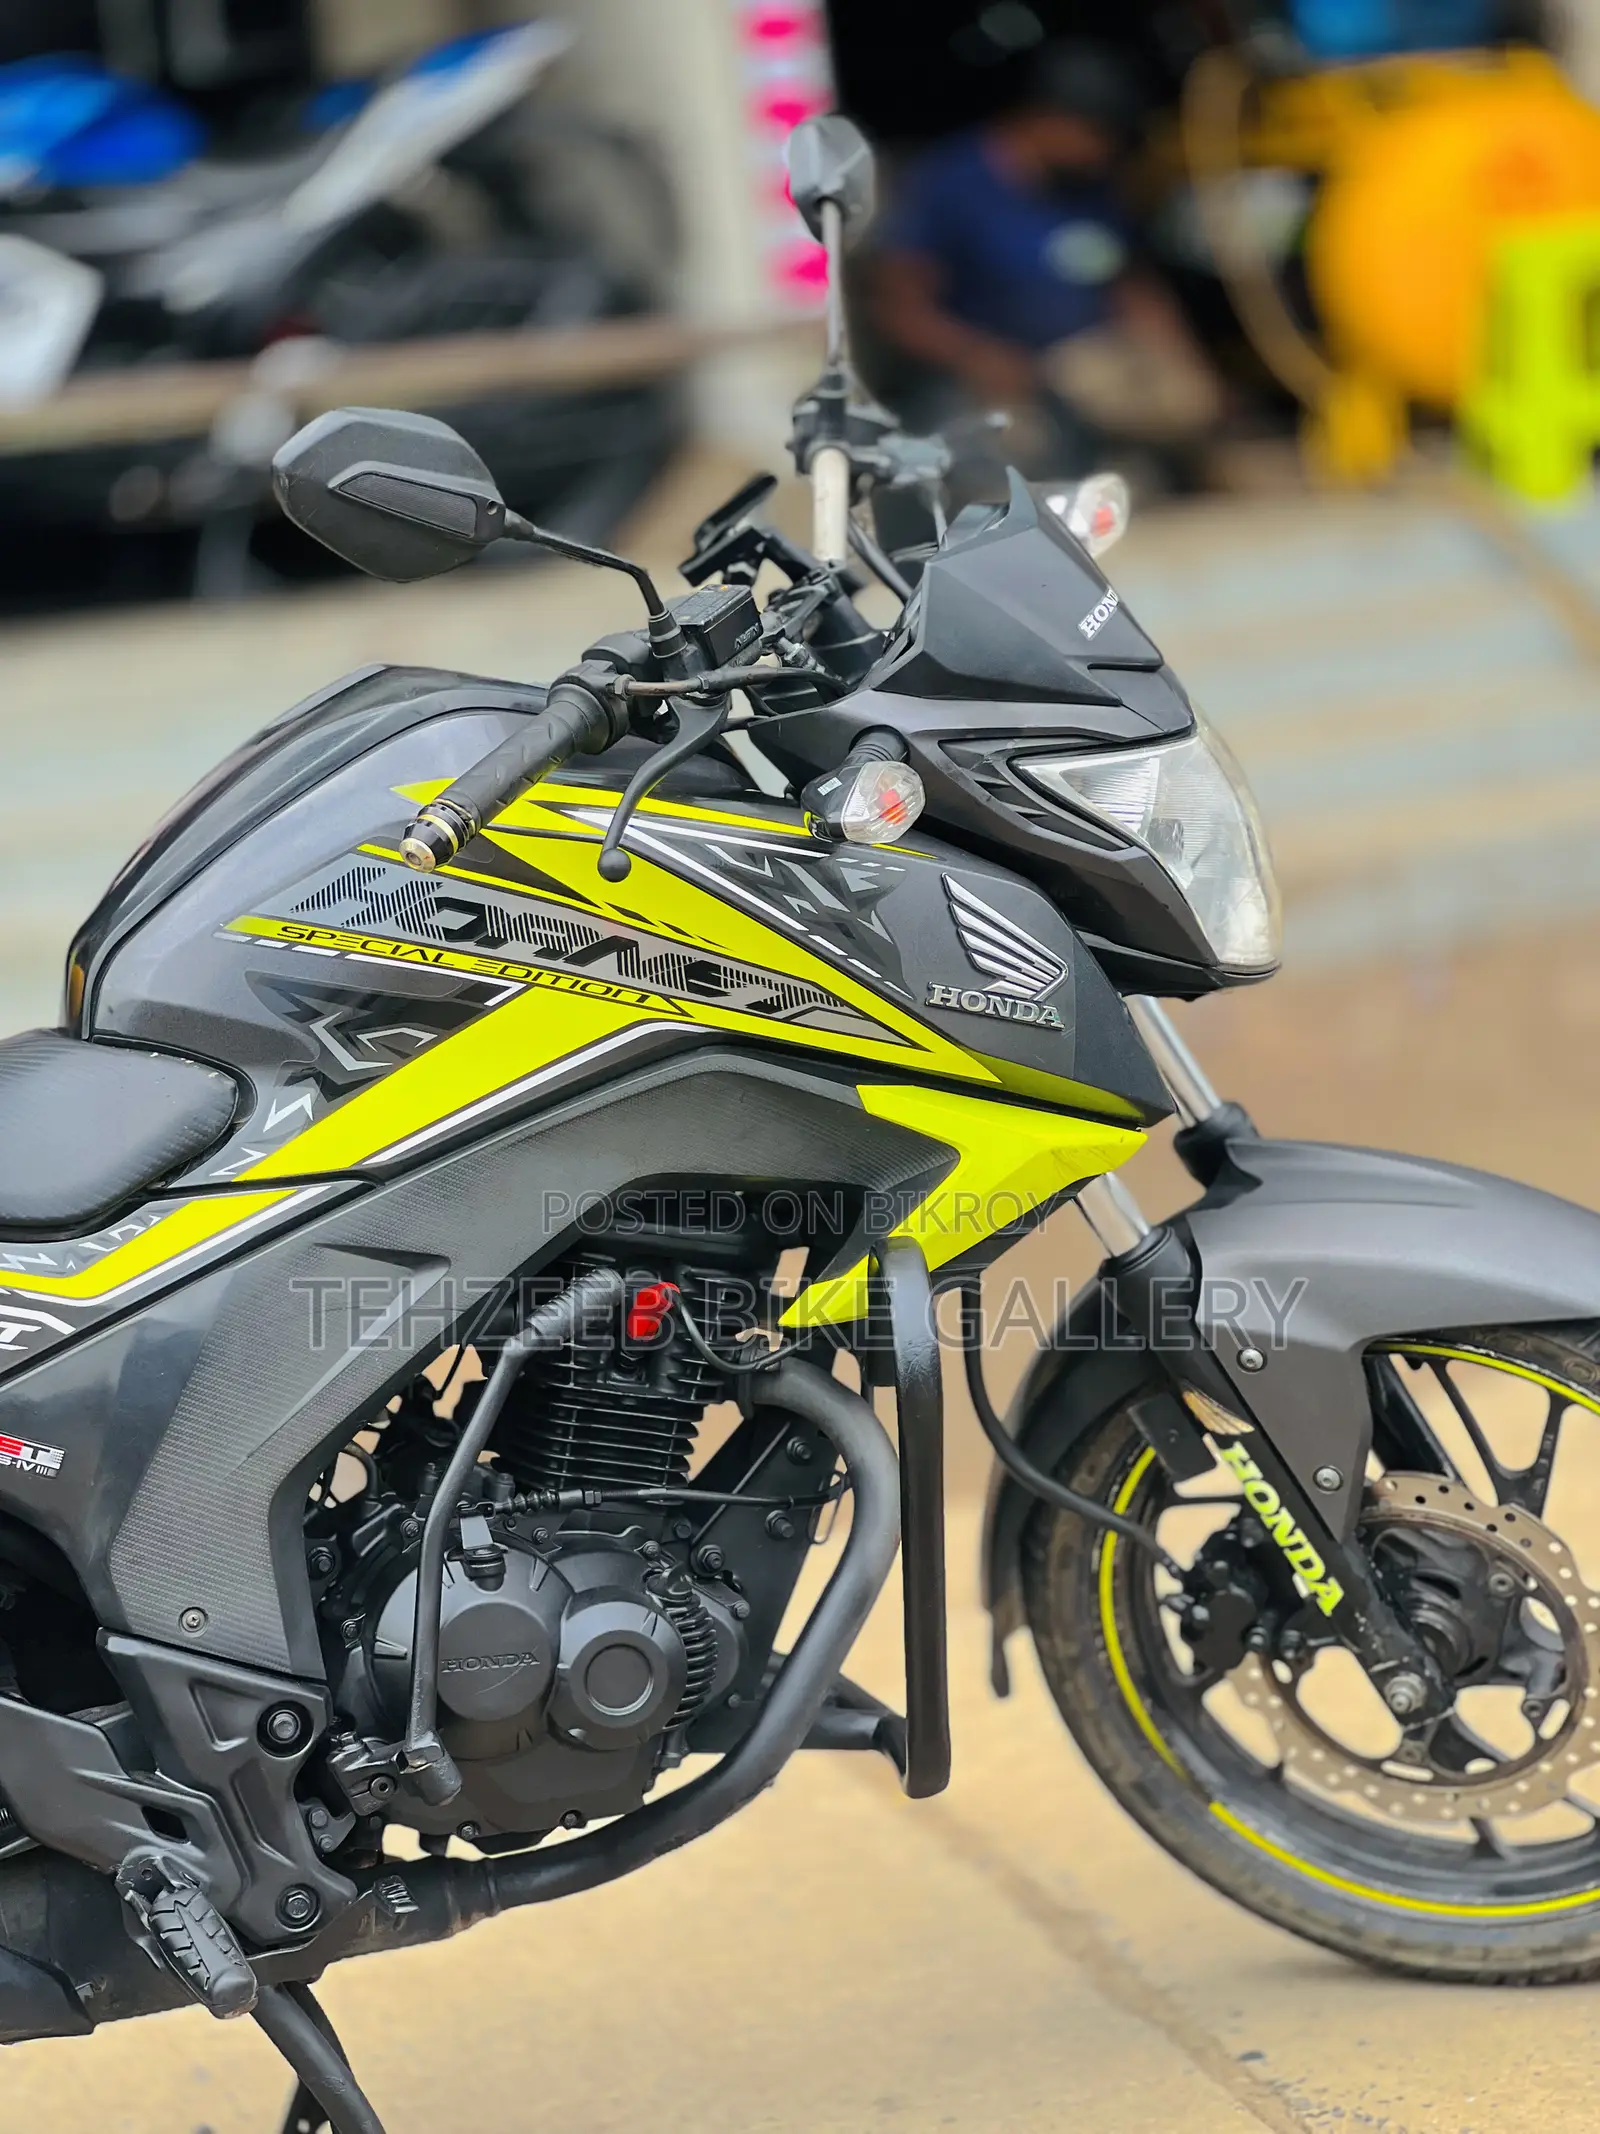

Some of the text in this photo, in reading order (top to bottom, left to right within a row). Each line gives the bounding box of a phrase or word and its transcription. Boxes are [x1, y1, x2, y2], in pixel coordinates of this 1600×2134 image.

[277, 925, 651, 1004] SPECIAL EDITION
[926, 983, 1065, 1030] HONDA
[1220, 1441, 1345, 1617] HONDA
[440, 1652, 541, 1673] HONDA
